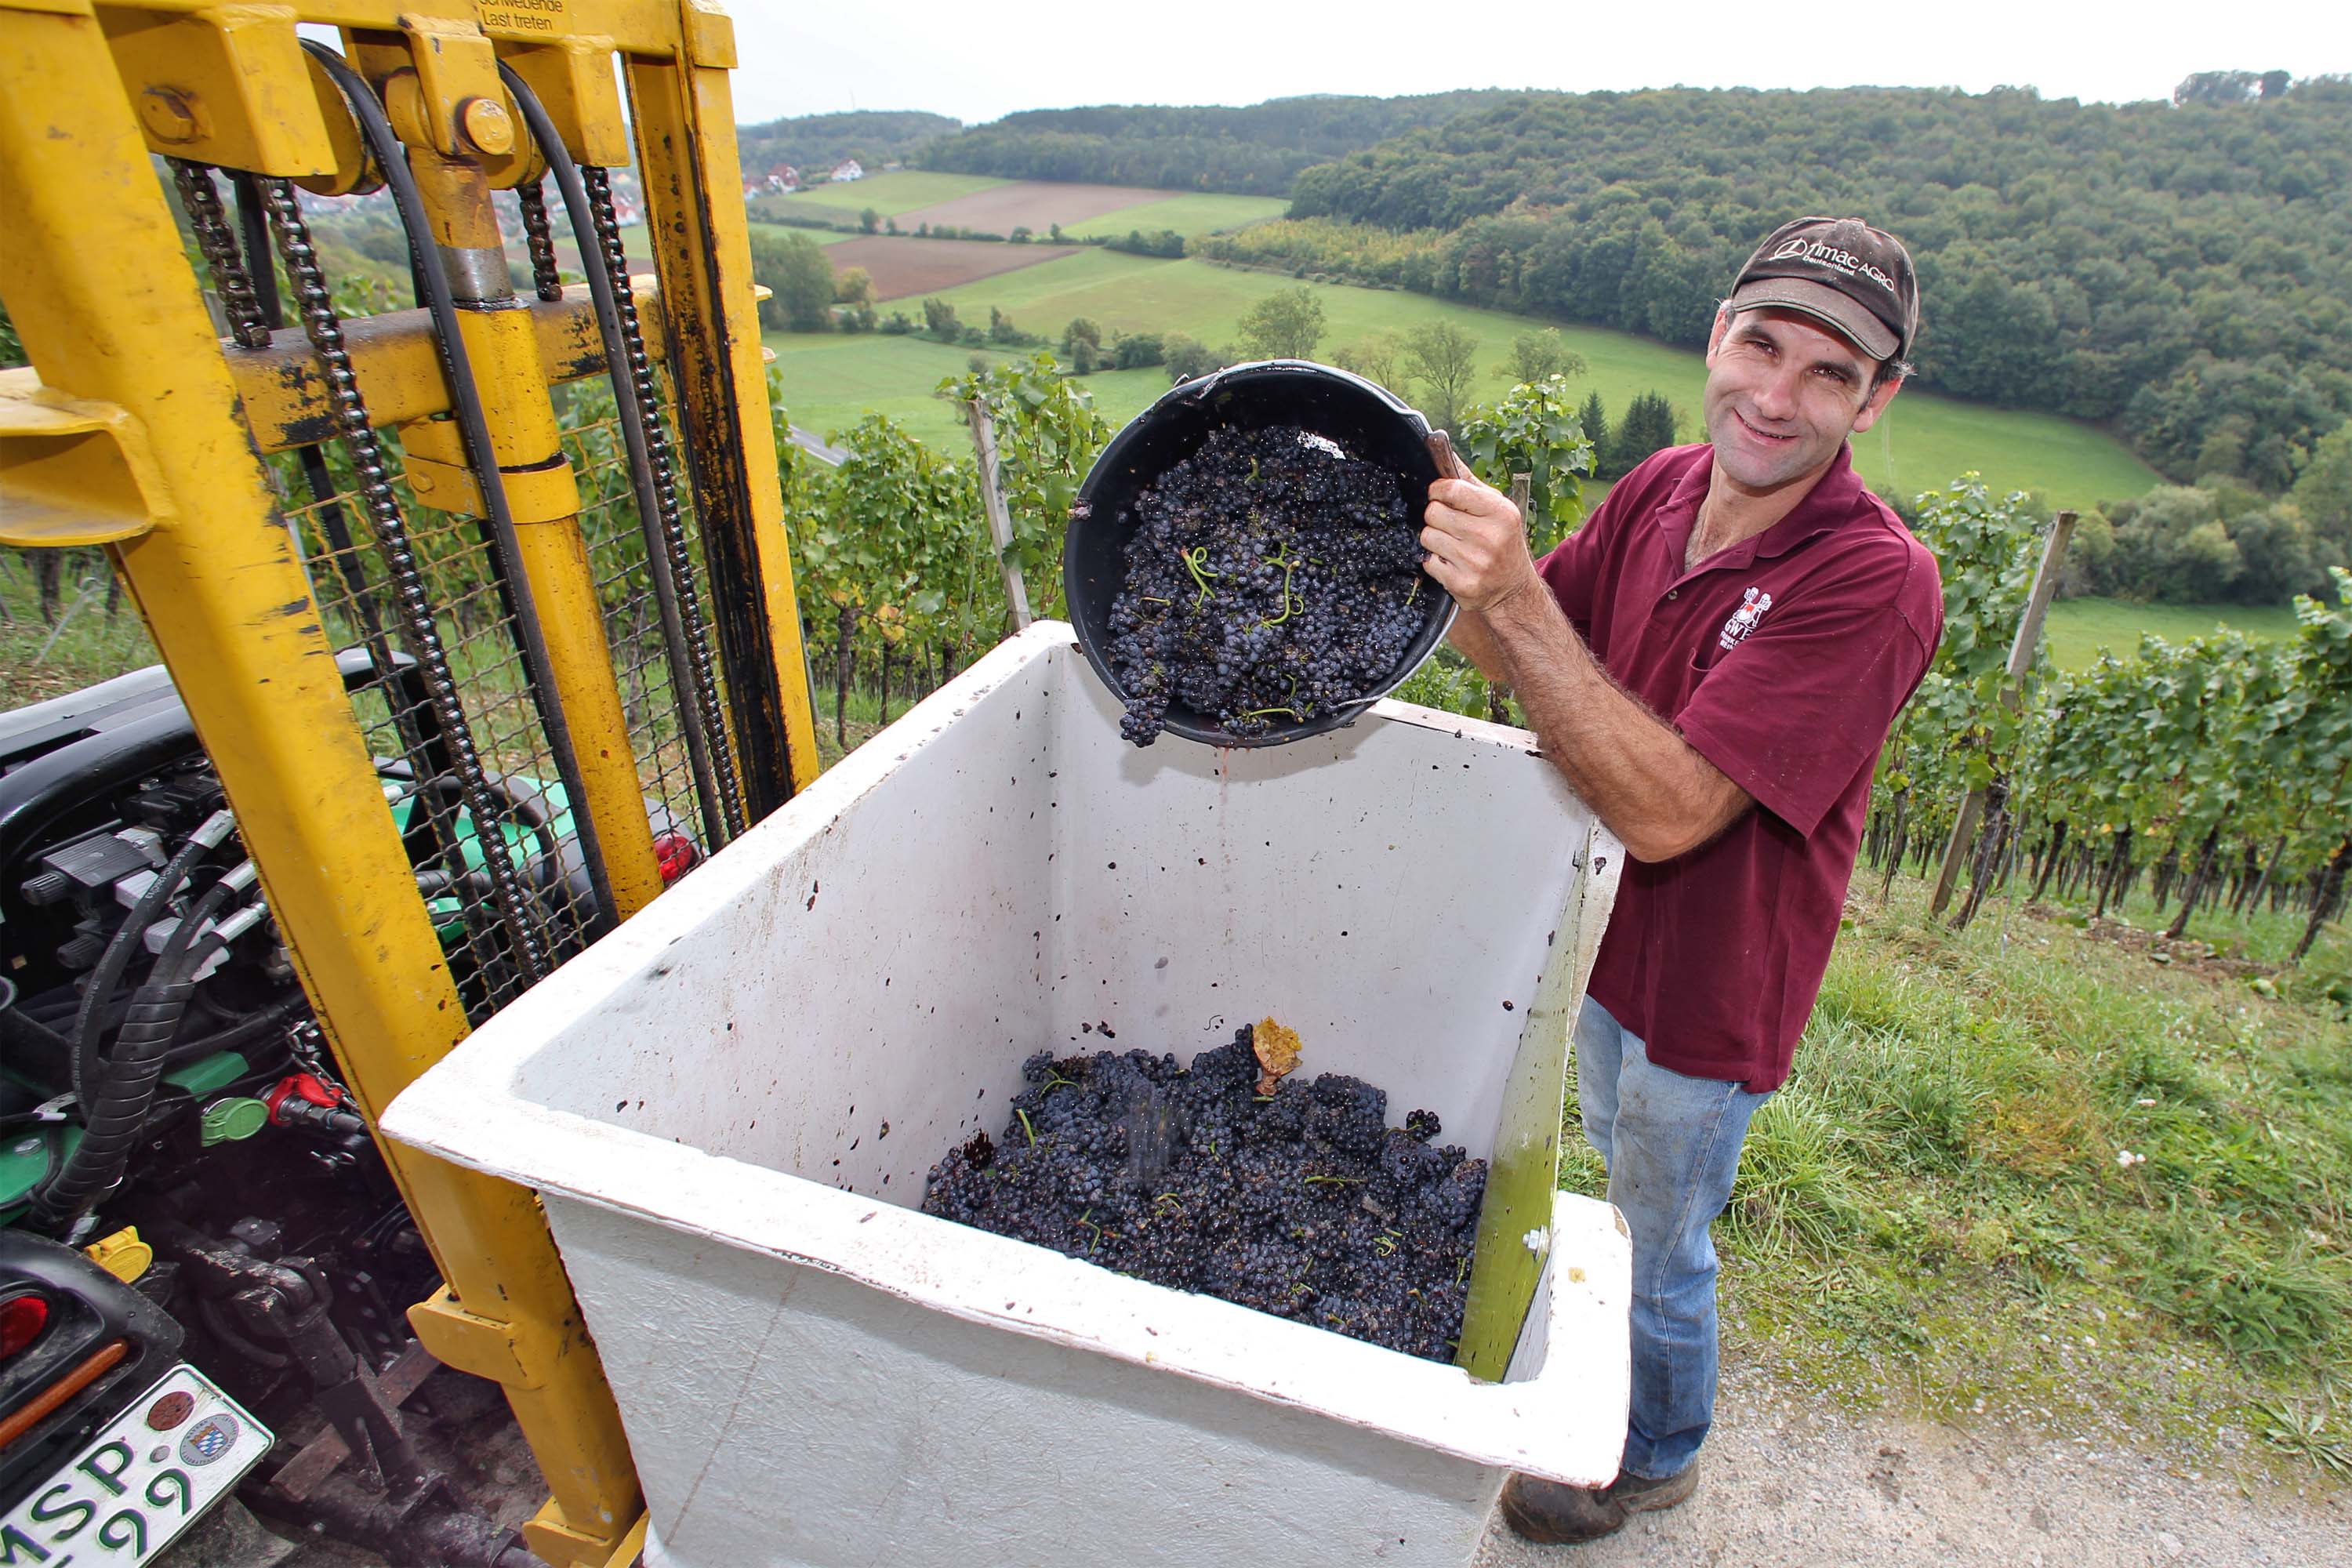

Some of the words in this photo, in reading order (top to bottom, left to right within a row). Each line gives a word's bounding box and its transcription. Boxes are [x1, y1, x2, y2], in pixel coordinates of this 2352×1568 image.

[481, 9, 512, 27] Last
[514, 13, 553, 31] treten
[1858, 263, 1895, 292] AGRO
[98, 1468, 193, 1559] 99
